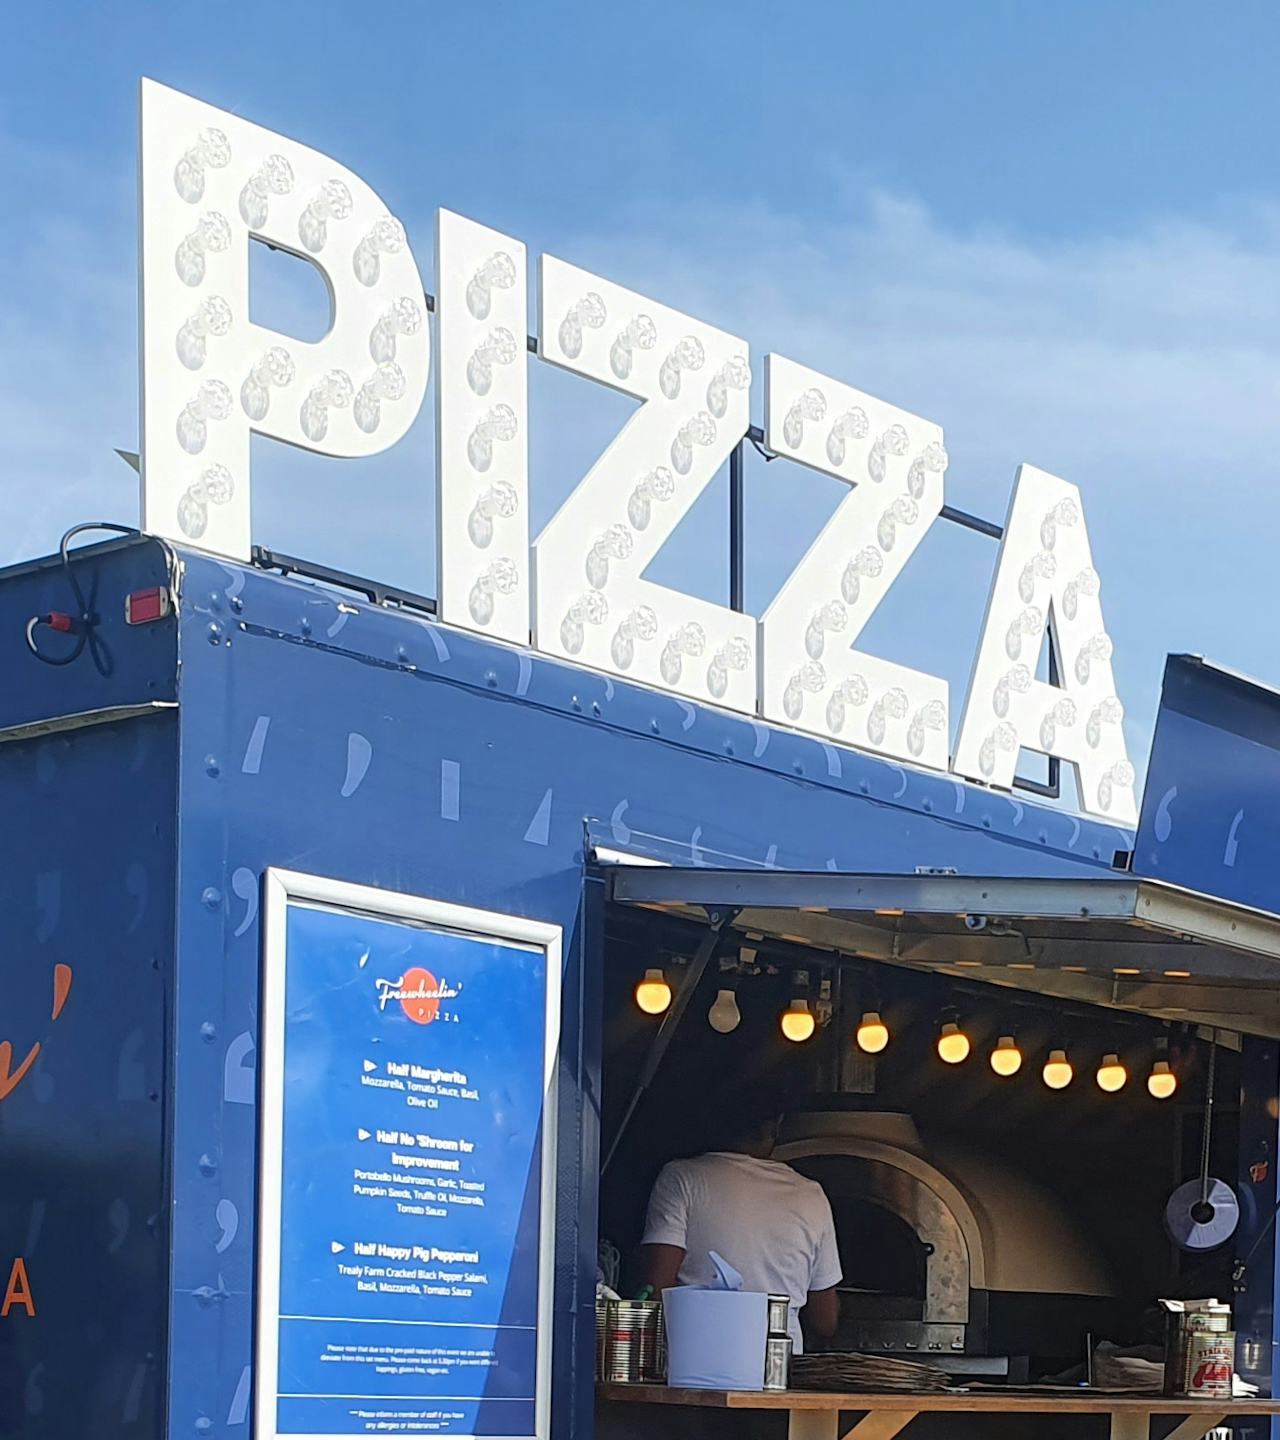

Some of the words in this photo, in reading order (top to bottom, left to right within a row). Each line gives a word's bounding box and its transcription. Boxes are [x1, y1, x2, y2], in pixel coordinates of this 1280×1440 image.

[140, 76, 1138, 826] PIZZA
[418, 1008, 460, 1023] PIZZA
[387, 1062, 409, 1076] Half
[411, 1065, 467, 1084] Margherita
[361, 1075, 405, 1090] Mozzarella,
[407, 1081, 436, 1094] Tomato
[437, 1085, 459, 1098] Sauce,
[407, 1096, 426, 1107] Olive
[427, 1098, 438, 1108] Oil
[376, 1130, 398, 1144] Half
[400, 1132, 415, 1146] No
[460, 1139, 474, 1152] for
[391, 1152, 460, 1171] Improvement
[354, 1185, 387, 1197] Pumpkin
[397, 1203, 424, 1215] Tomato
[425, 1206, 447, 1217] Sauce
[354, 1242, 376, 1256] Half
[378, 1244, 411, 1260] Happy
[413, 1246, 430, 1262] Pig
[431, 1248, 479, 1263] Pepperoni
[365, 1266, 384, 1276] Farm
[386, 1268, 417, 1279] Cracked
[418, 1269, 437, 1280] Black
[438, 1271, 464, 1282] Pepper
[423, 1285, 450, 1295] Tomato
[452, 1286, 472, 1297] Sauce
